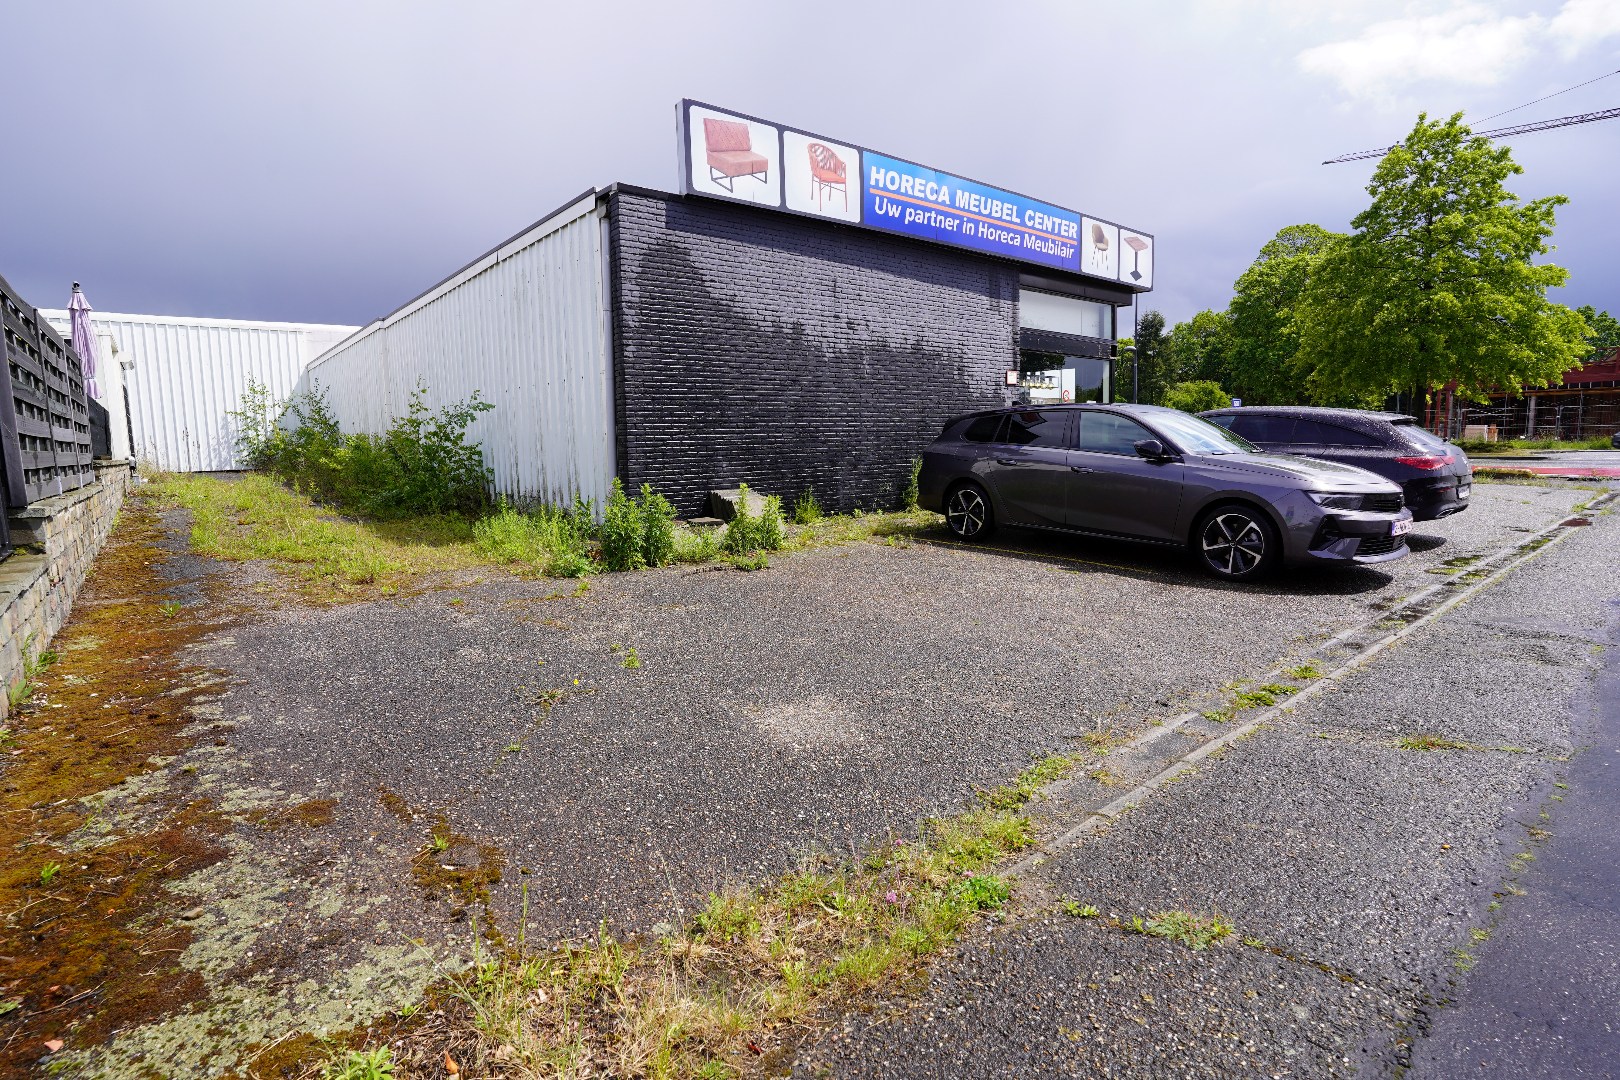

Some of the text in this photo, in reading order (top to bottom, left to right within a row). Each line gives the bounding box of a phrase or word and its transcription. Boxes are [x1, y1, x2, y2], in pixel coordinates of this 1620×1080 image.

[869, 166, 1077, 238] HORECA MEUBEL CENTER
[874, 196, 1075, 259] Uw partner in Horeca Meubilair
